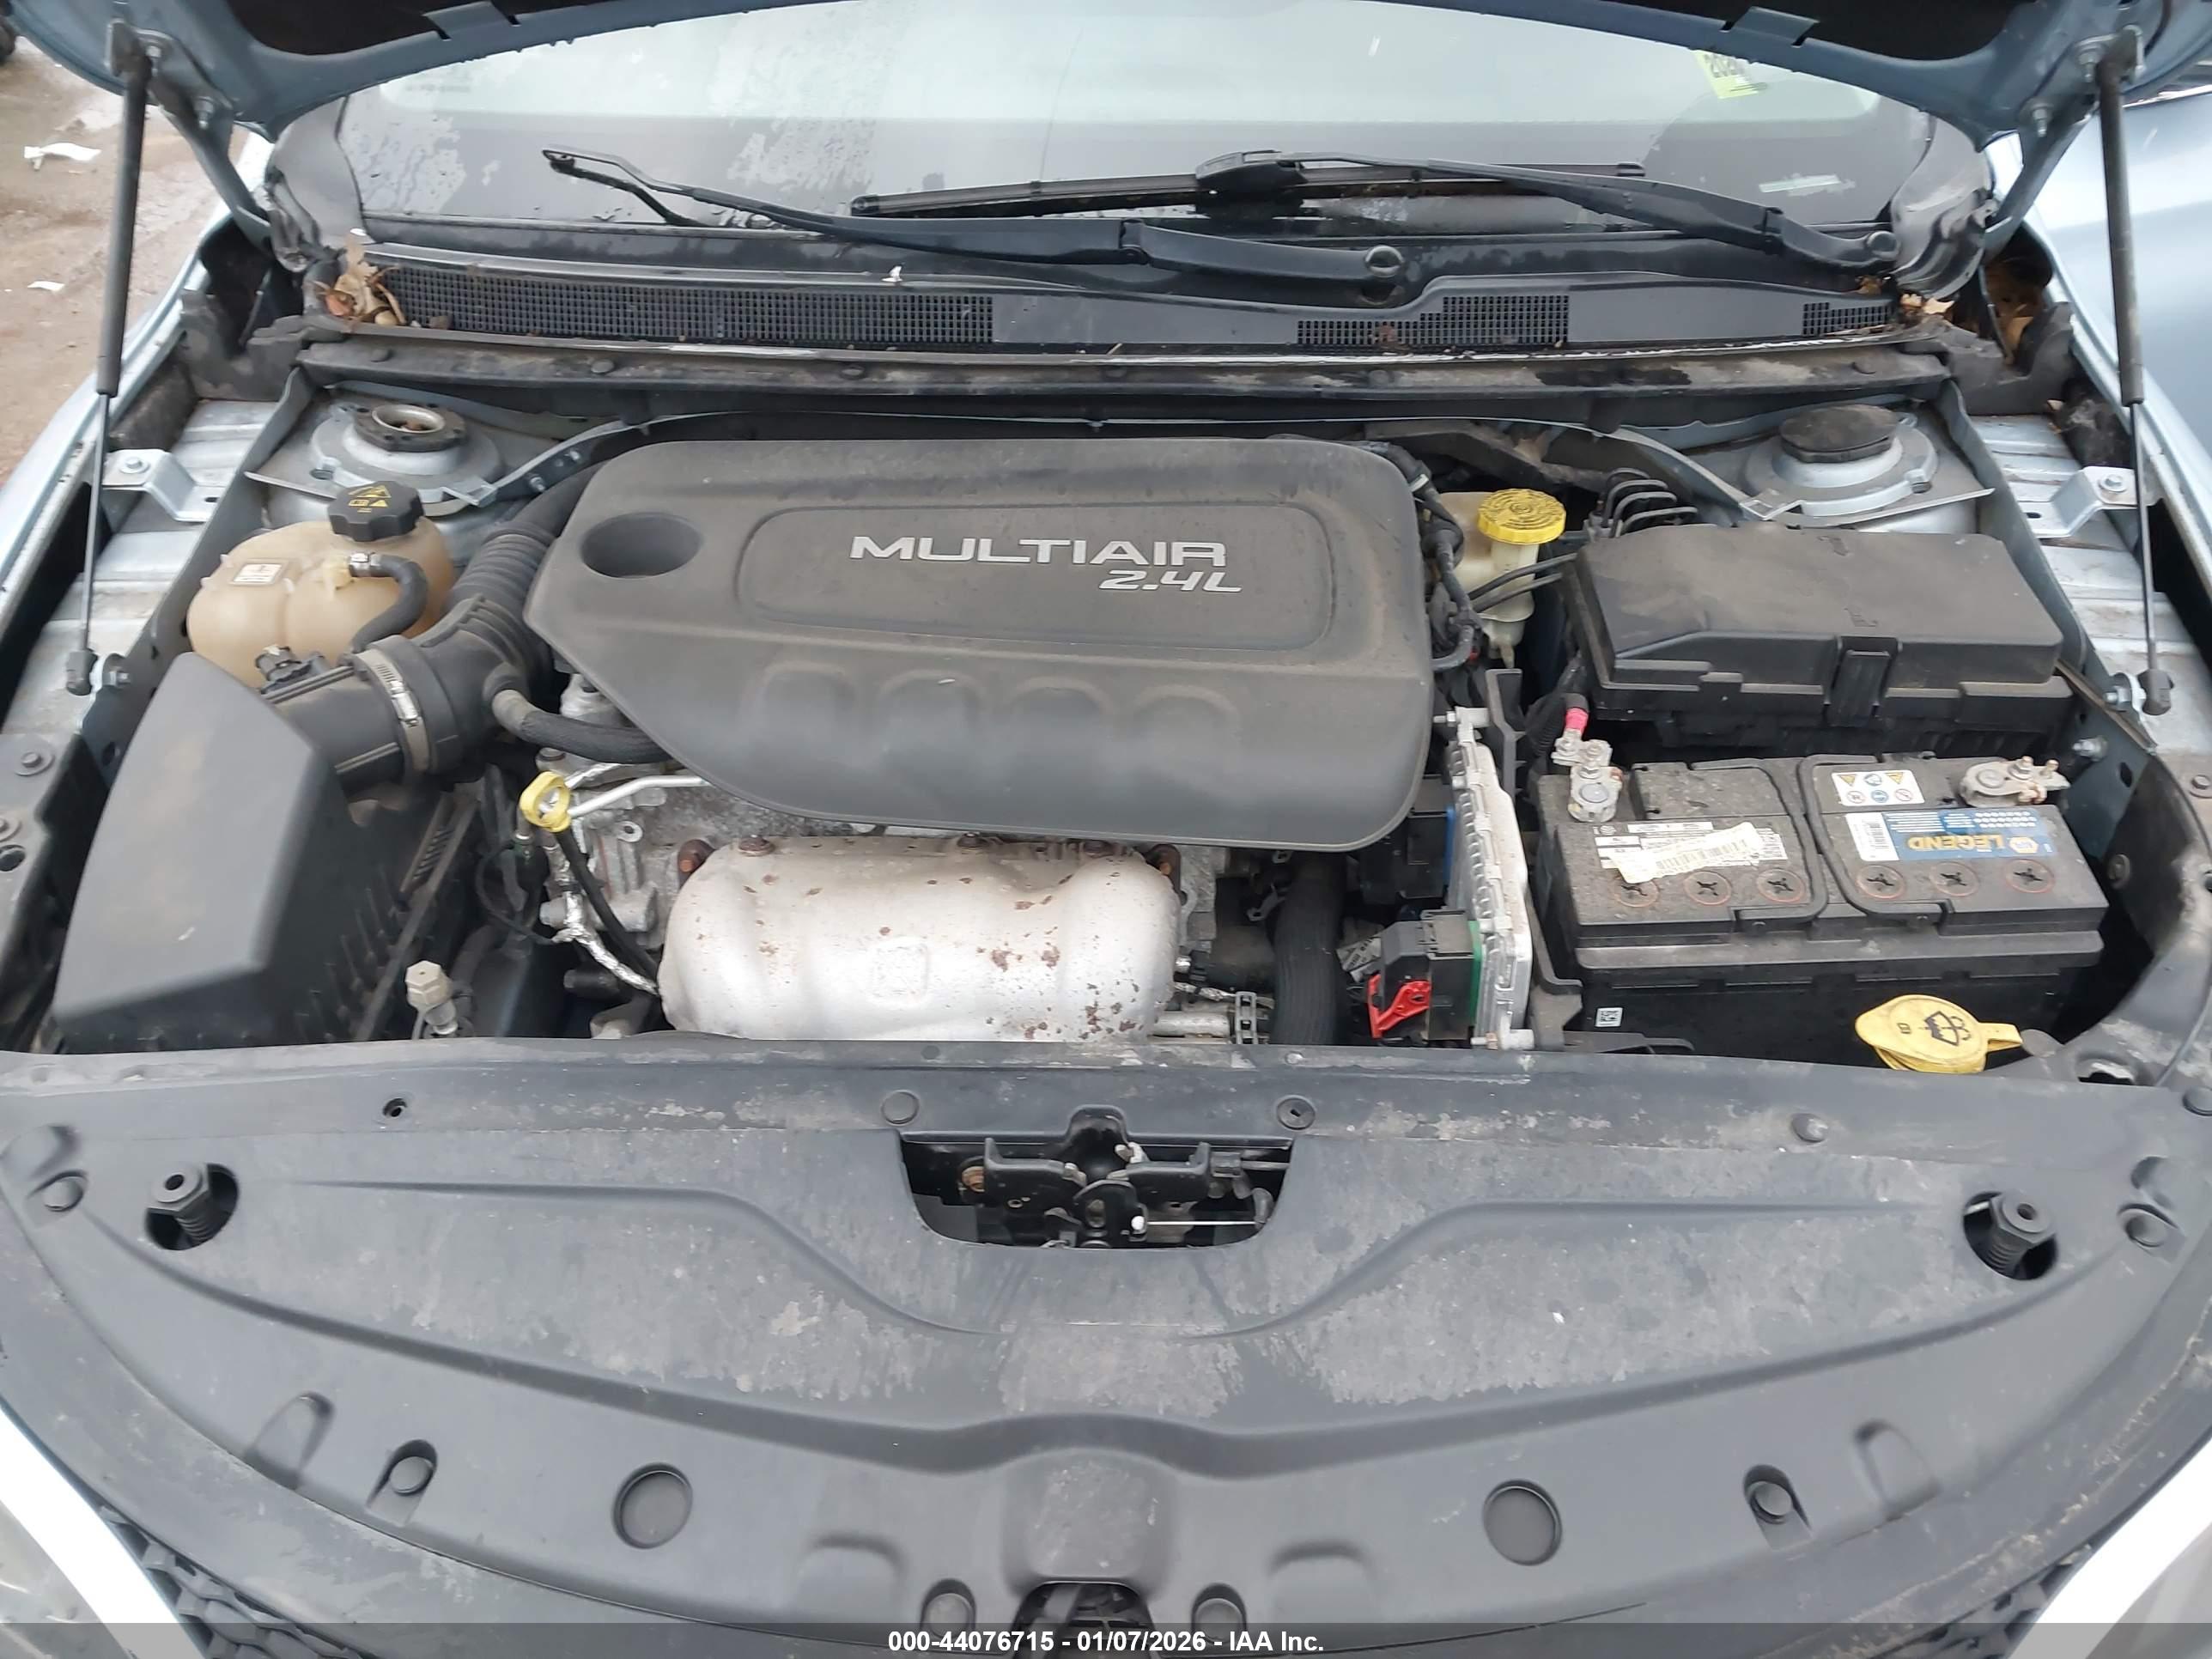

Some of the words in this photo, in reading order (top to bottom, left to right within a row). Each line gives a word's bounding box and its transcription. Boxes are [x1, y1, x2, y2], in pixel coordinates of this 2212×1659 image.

[849, 535, 1227, 568] MULTIAIR
[1098, 568, 1243, 593] 2.4L
[1907, 834, 2005, 851] LEGEND
